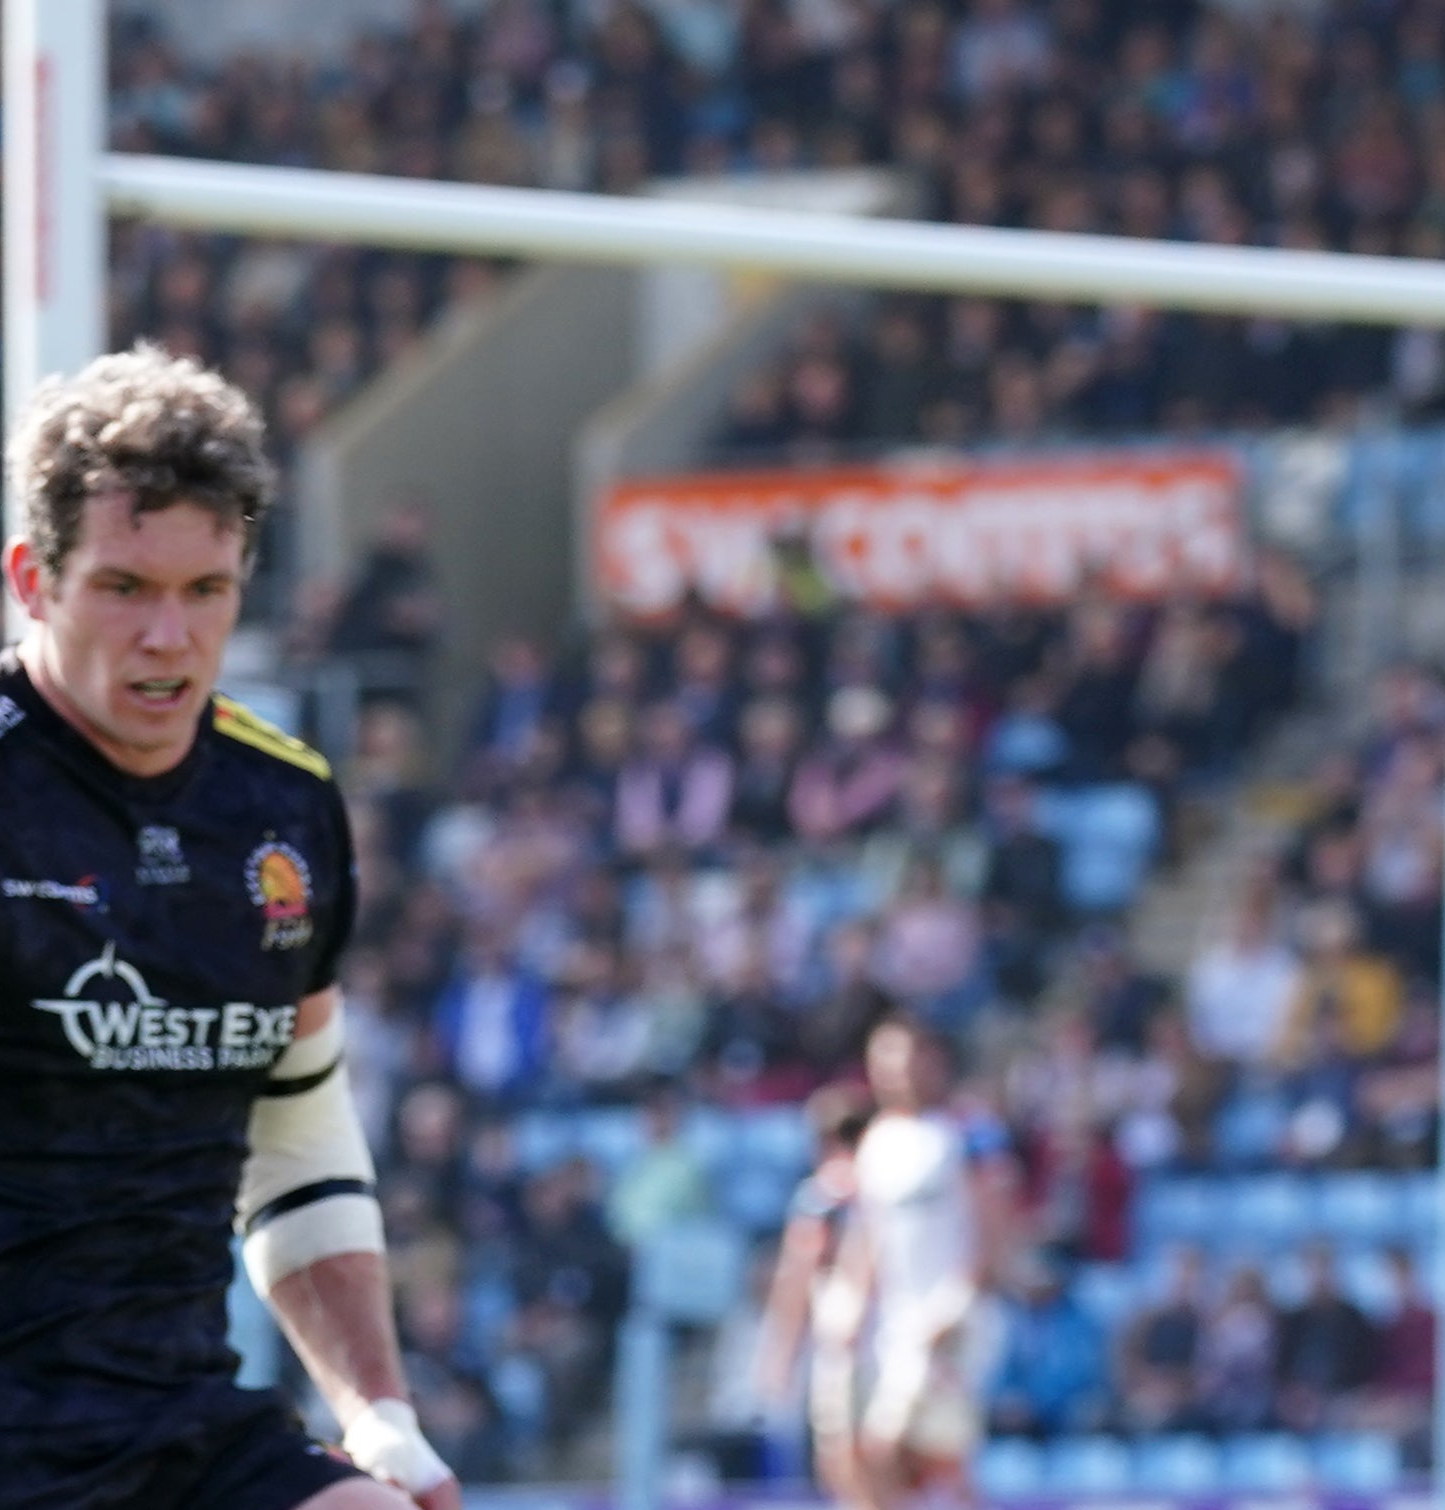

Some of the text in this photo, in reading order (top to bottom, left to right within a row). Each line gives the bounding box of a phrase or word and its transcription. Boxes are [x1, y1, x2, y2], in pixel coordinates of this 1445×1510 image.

[84, 1000, 298, 1047] WEST EXE
[89, 1046, 214, 1070] BUSINESS
